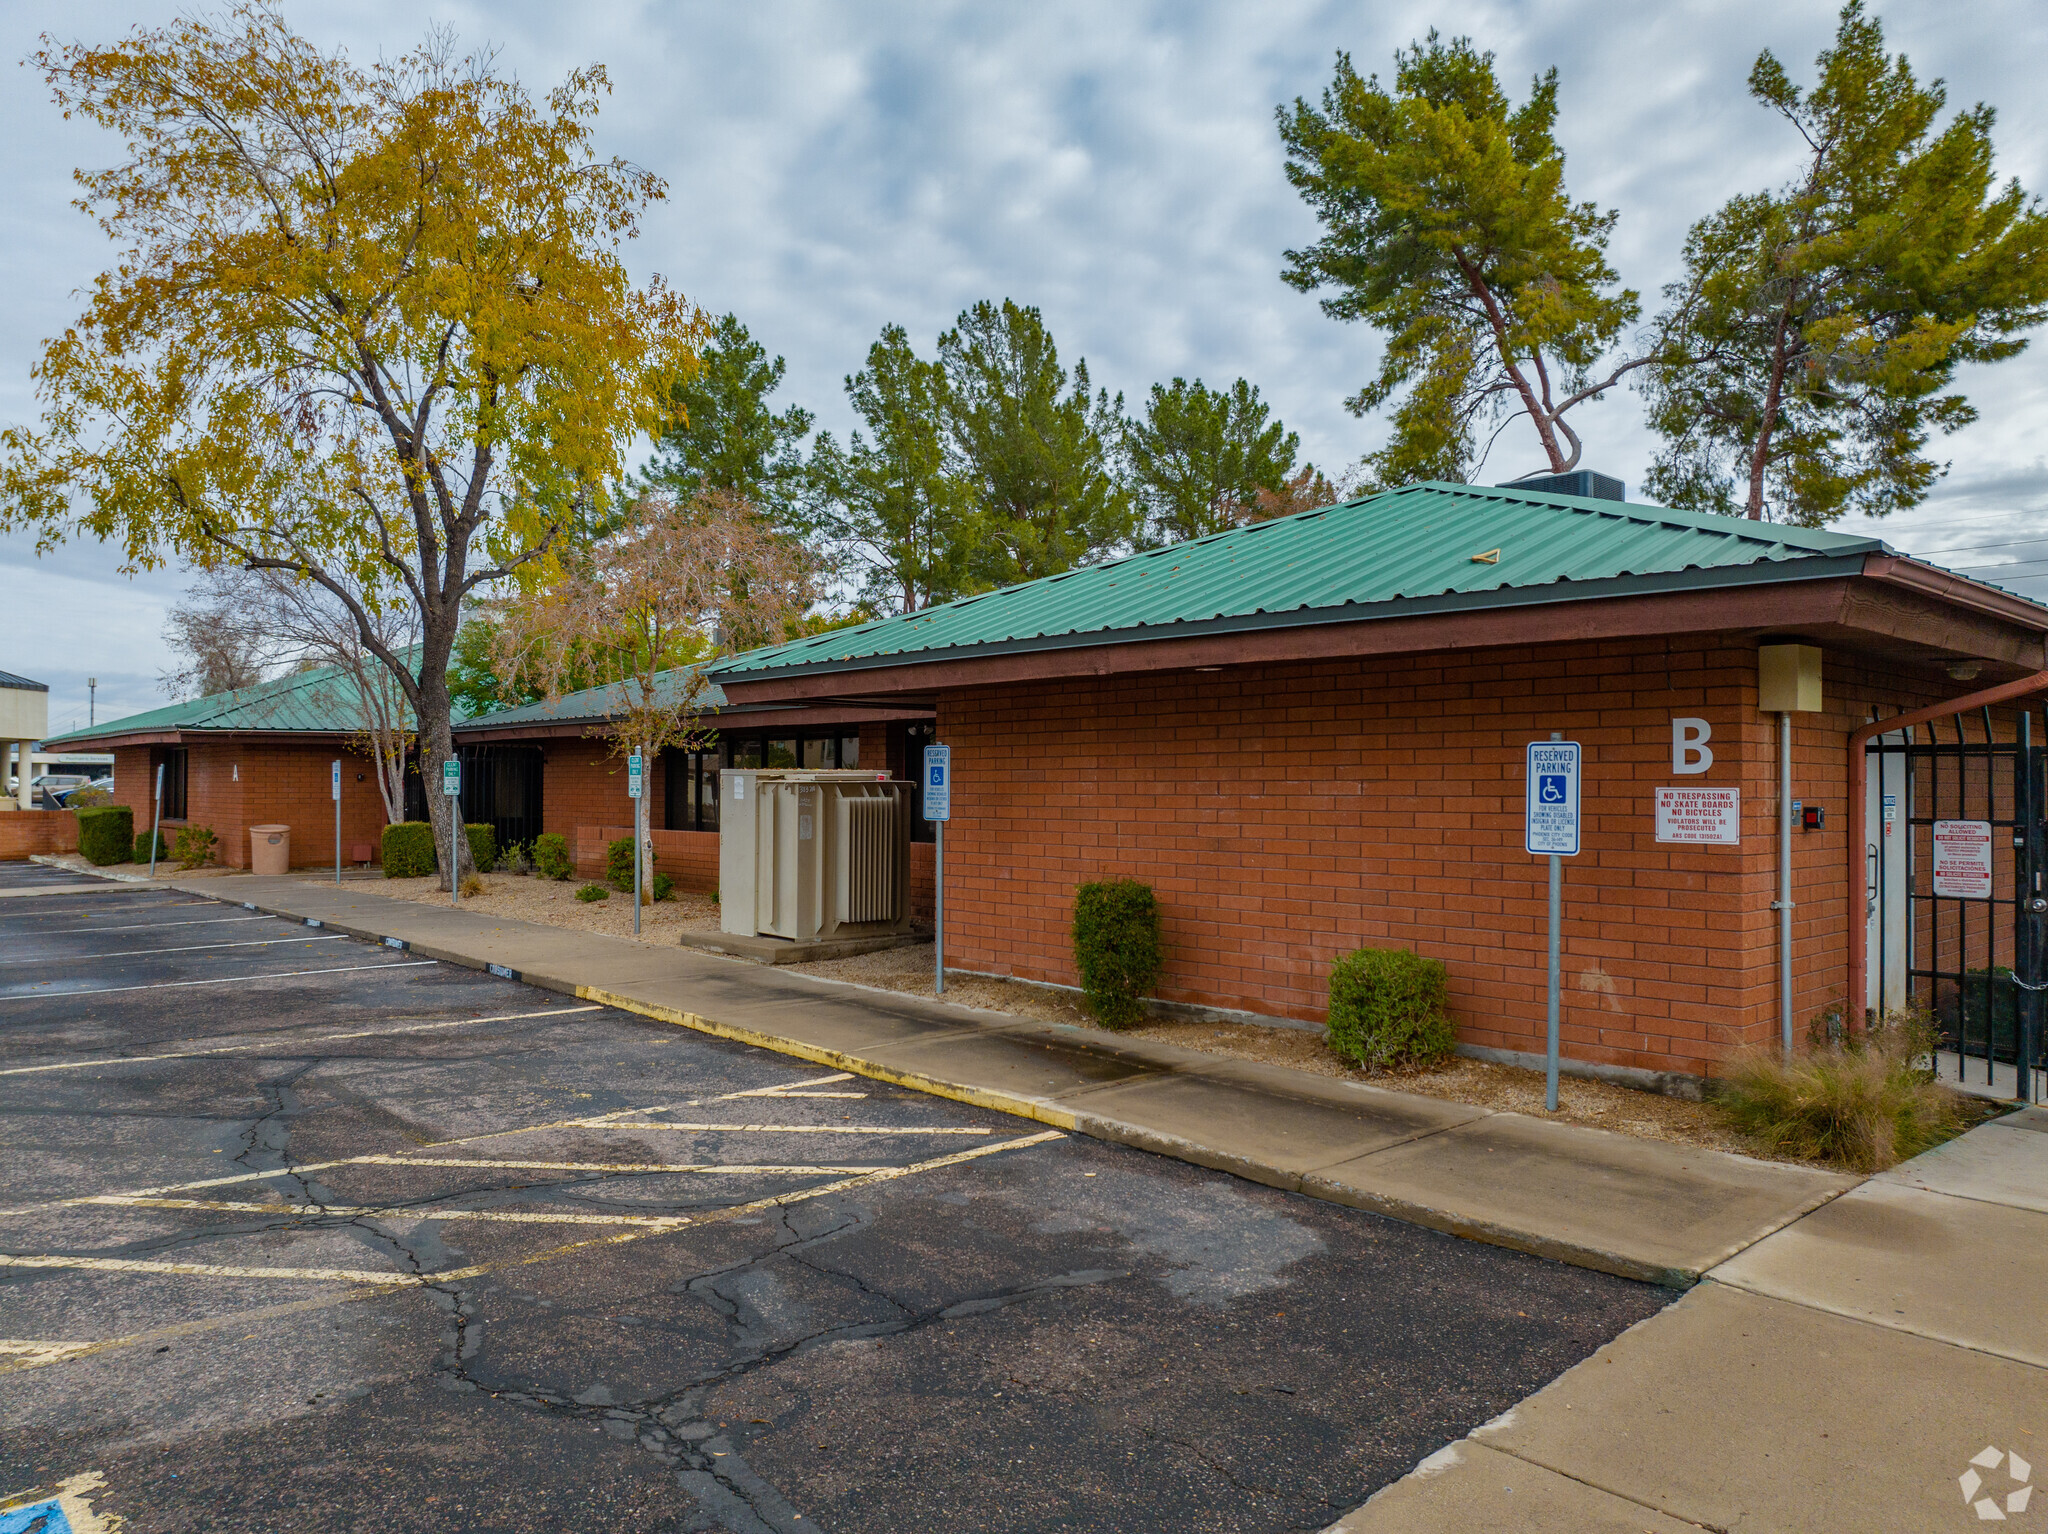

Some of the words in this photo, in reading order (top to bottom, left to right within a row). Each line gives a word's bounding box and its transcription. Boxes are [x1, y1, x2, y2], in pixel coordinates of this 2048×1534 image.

[1673, 718, 1714, 774] B
[1534, 751, 1574, 761] RESERVED
[233, 764, 238, 782] A
[1536, 763, 1571, 773] PARKING
[490, 963, 512, 978] CONSUMER
